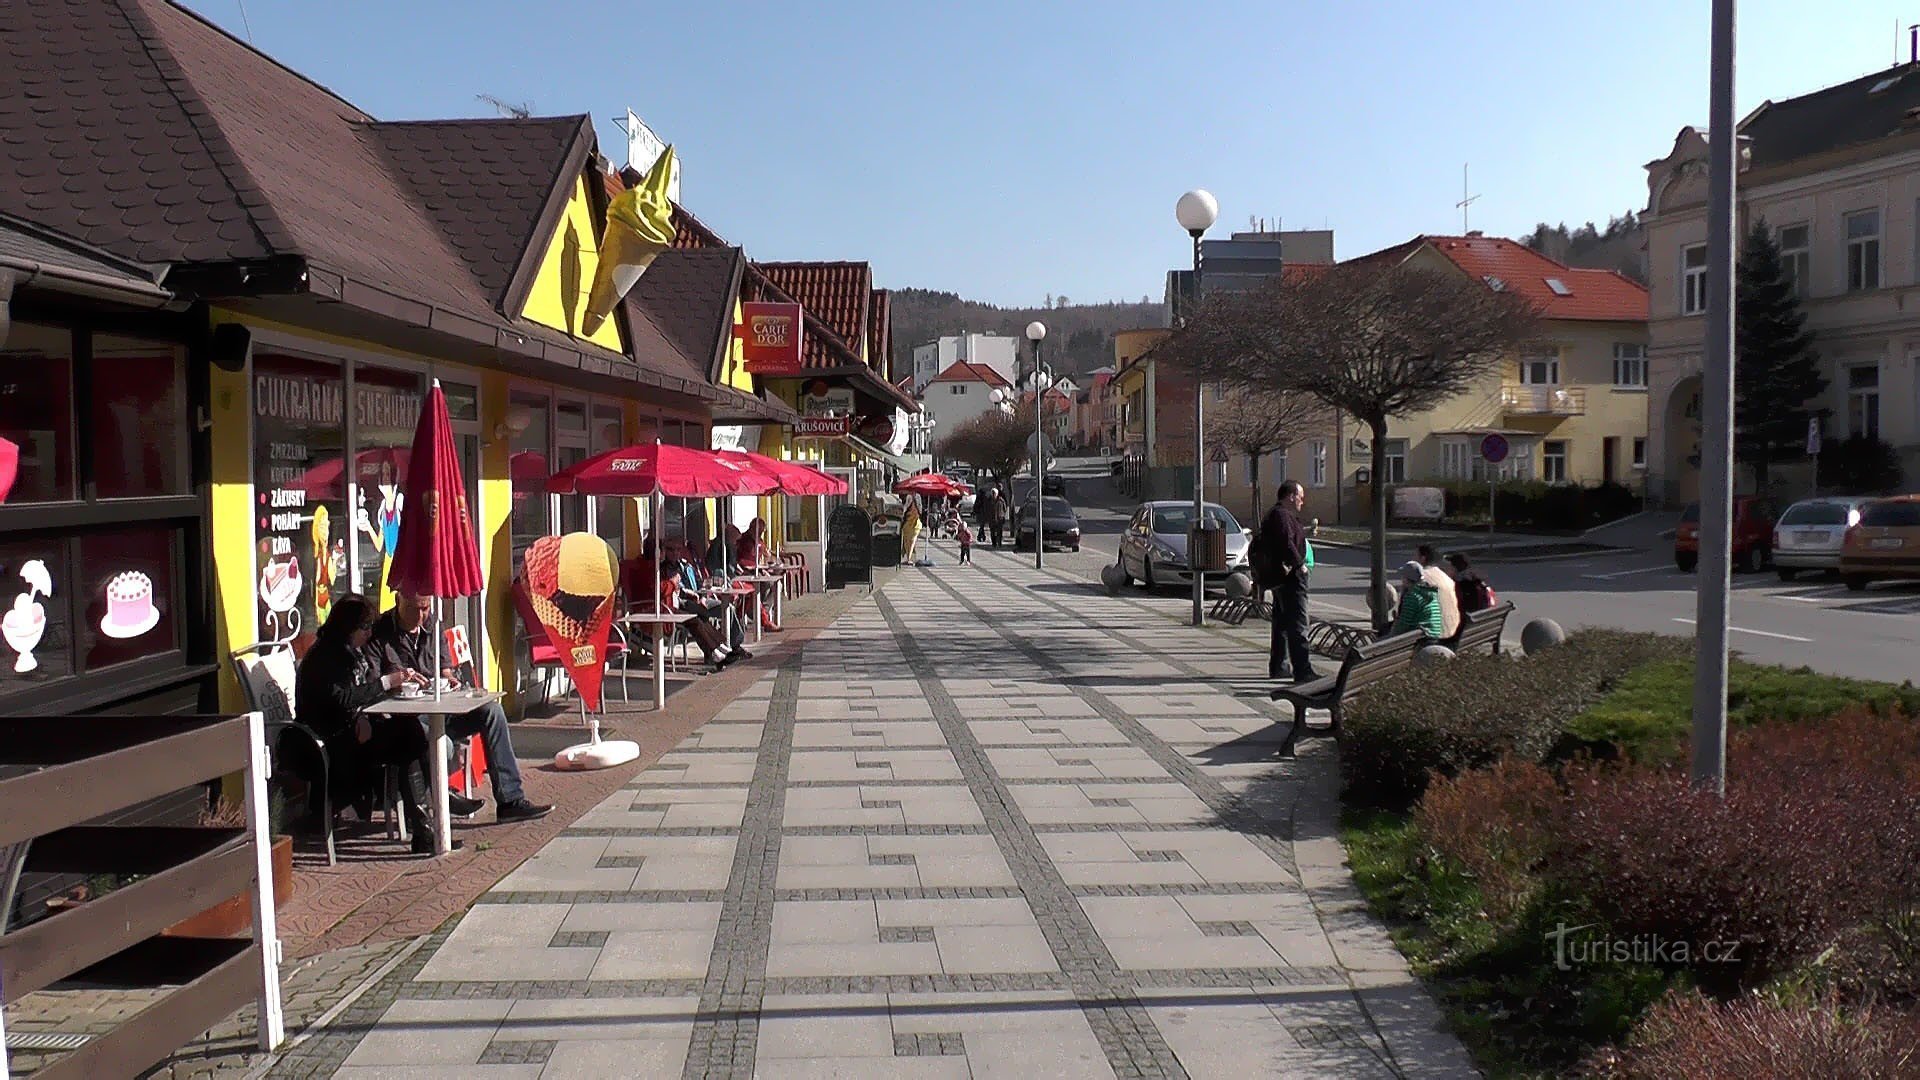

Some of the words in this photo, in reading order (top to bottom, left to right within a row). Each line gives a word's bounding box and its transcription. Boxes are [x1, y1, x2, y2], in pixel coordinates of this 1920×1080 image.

[753, 323, 787, 335] CARTE
[757, 333, 785, 345] D'OR
[256, 376, 343, 423] CUKRÁRNA
[794, 420, 845, 433] KRUŠOVICE
[271, 488, 306, 508] ZÁKUSKY
[271, 511, 301, 532] POHÁRY
[272, 536, 292, 555] KÁVA
